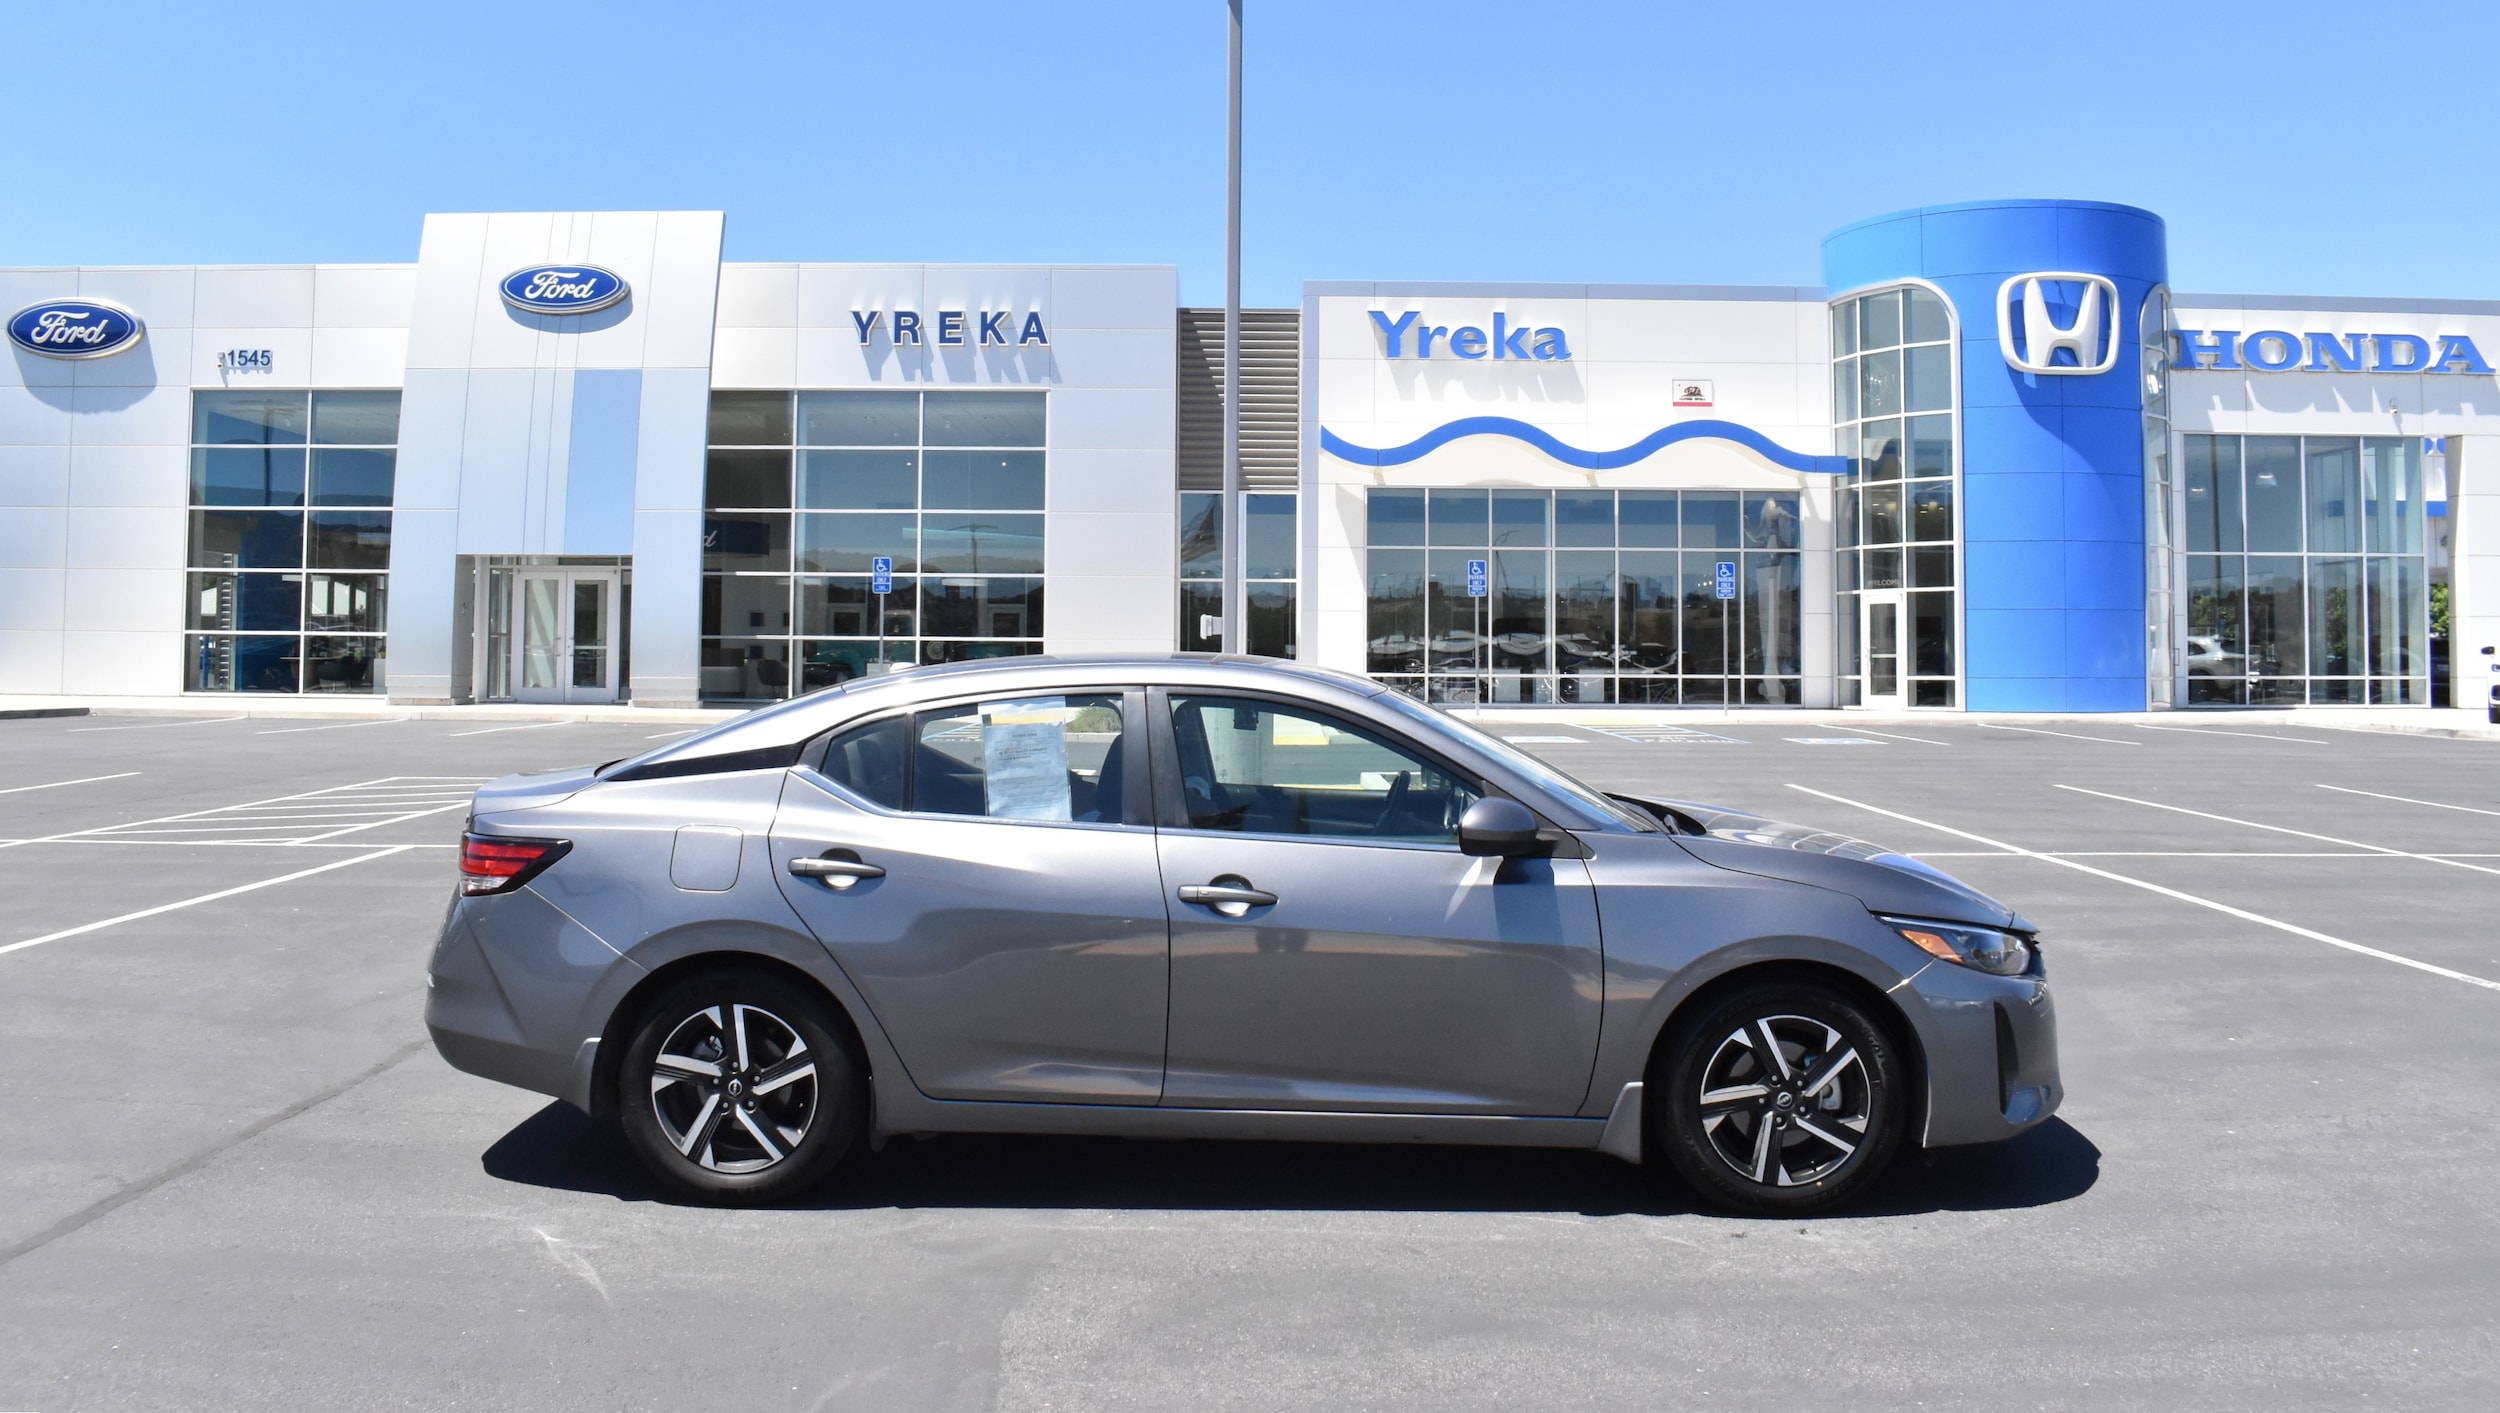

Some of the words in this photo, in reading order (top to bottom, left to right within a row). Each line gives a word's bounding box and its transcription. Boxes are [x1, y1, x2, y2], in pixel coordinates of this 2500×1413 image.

[524, 271, 597, 299] Ford
[31, 310, 109, 344] Ford
[850, 310, 1051, 346] YREKA
[1367, 310, 1571, 360] Yreka
[227, 349, 271, 366] 1545
[2170, 329, 2497, 375] HONDA
